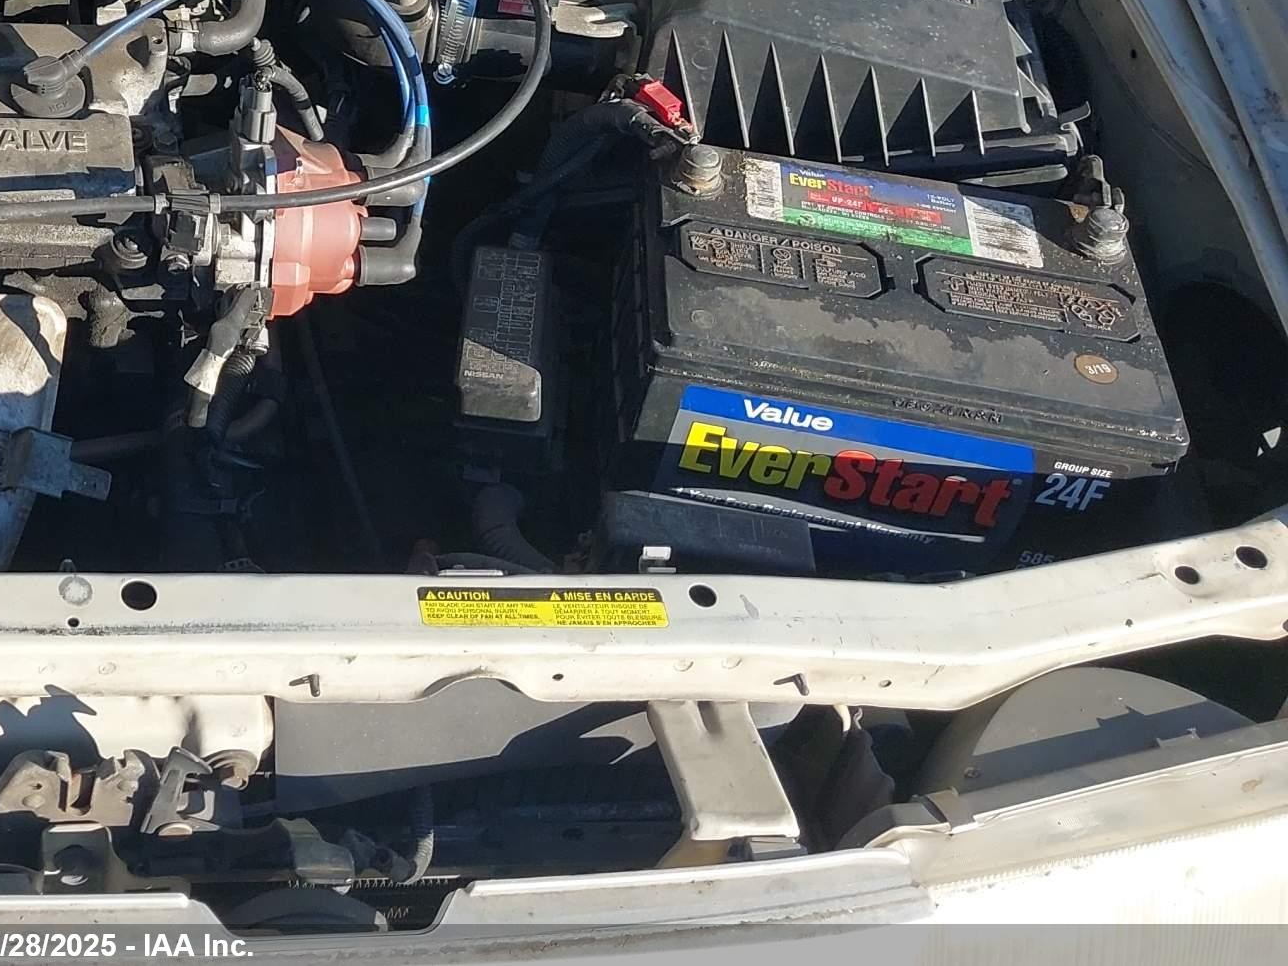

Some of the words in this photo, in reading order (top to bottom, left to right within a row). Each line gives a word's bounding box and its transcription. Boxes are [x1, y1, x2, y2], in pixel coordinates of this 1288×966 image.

[789, 172, 870, 196] EverStart
[724, 228, 778, 246] DANGER
[792, 240, 842, 254] POISON
[464, 369, 504, 380] NISSAN
[744, 399, 834, 432] Value
[678, 421, 1011, 528] EverStart
[1054, 461, 1089, 474] GROUP
[1090, 465, 1114, 478] SIZE
[1036, 473, 1111, 511] 24F
[689, 489, 724, 507] Year
[725, 497, 760, 512] Free
[762, 503, 863, 530] Replacement
[866, 522, 935, 544] Warranty
[437, 591, 490, 600] CAUTION
[564, 592, 592, 601] MISE
[595, 592, 613, 601] EN
[614, 593, 657, 601] GARDE
